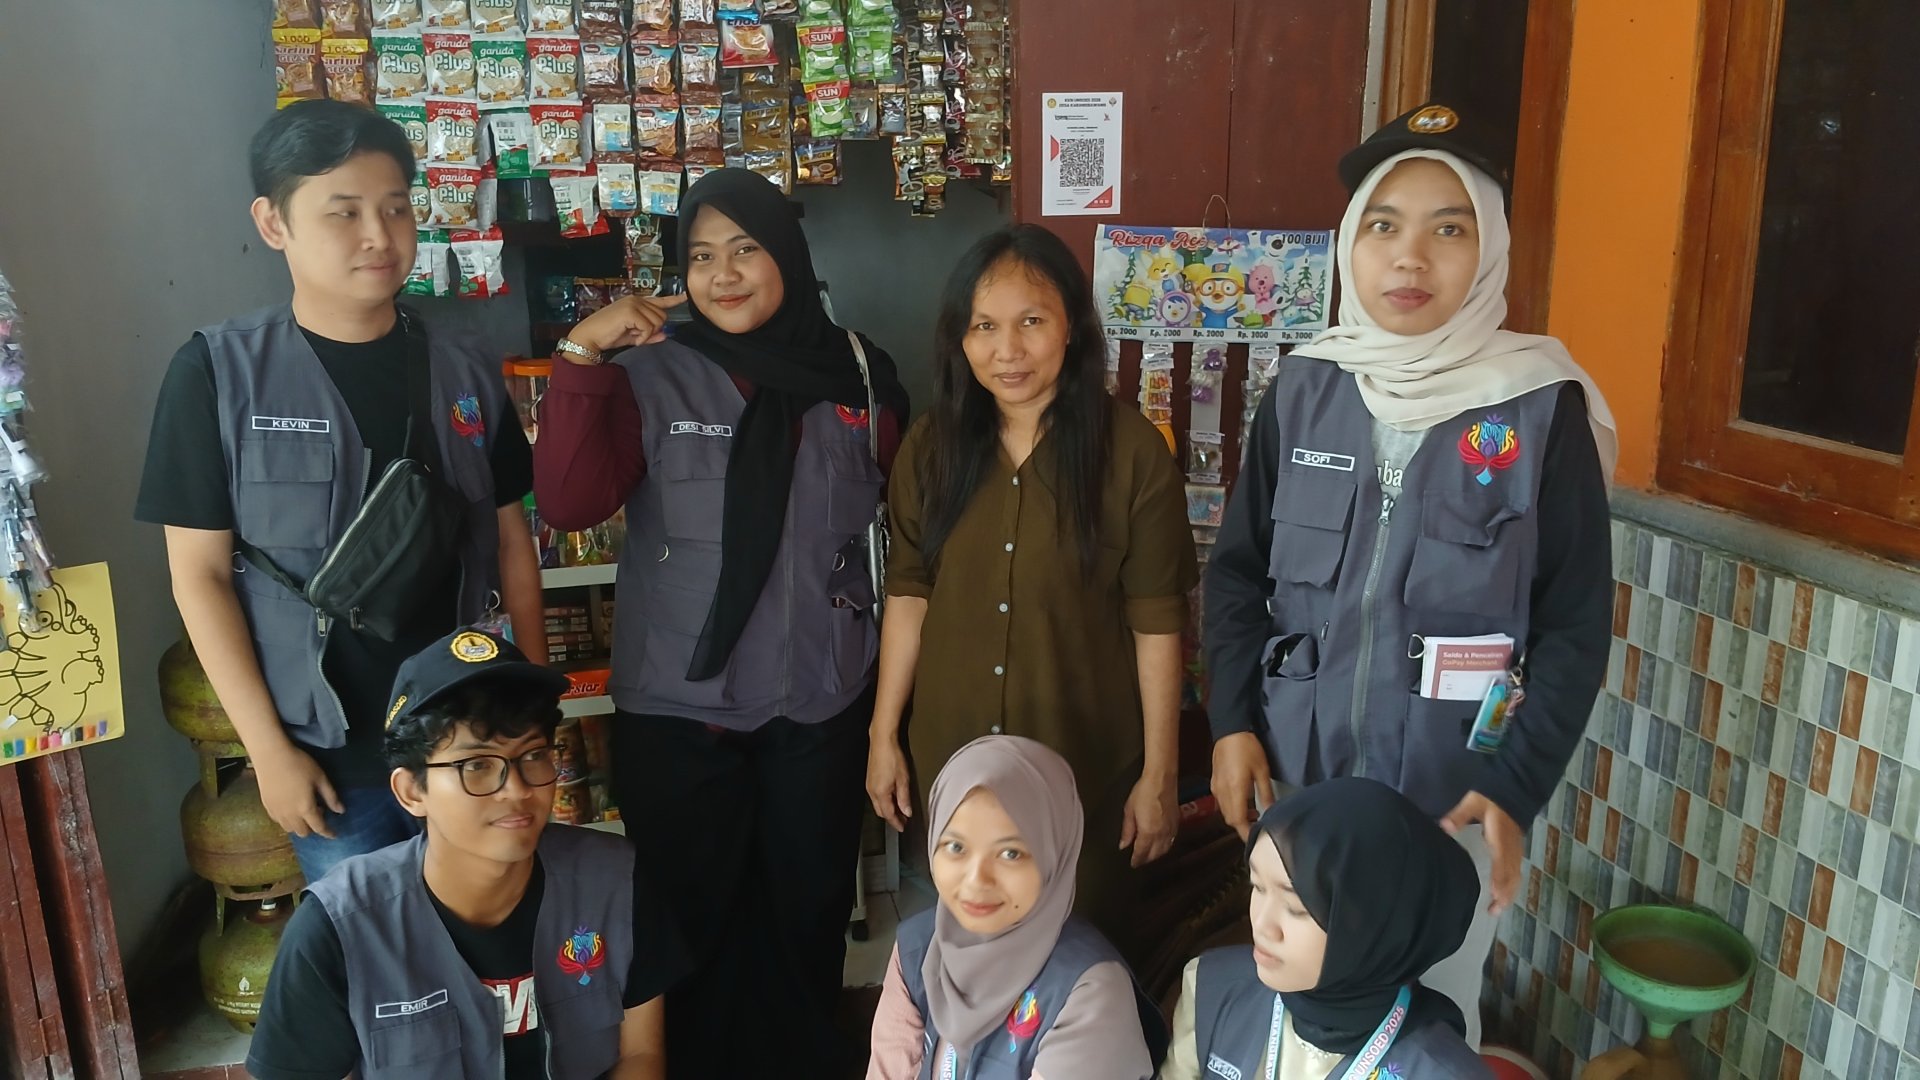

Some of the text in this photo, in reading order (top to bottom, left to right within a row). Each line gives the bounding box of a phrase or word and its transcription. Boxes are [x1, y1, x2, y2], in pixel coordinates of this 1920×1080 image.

[810, 33, 832, 42] SUN
[382, 43, 416, 51] garuda
[434, 40, 468, 48] garuda
[538, 44, 572, 52] garuda
[480, 47, 514, 56] garuda
[382, 55, 420, 73] Pilus
[434, 52, 472, 70] Pilus
[536, 56, 575, 73] Pilus
[817, 88, 839, 97] SUN
[438, 108, 472, 116] garuda
[541, 110, 574, 118] garuda
[437, 119, 474, 137] Pilus
[541, 121, 578, 139] Pilus
[439, 174, 473, 182] garuda
[438, 186, 475, 204] Pilus
[1282, 233, 1325, 245] 100 BIJI
[633, 278, 656, 288] TOP
[1193, 329, 1204, 337] Rp.
[1238, 331, 1248, 339] Rp.
[272, 419, 309, 429] KEVIN
[679, 423, 699, 431] DESI
[1303, 453, 1330, 463] SOFI
[401, 1000, 428, 1012] EMIR
[1355, 1032, 1389, 1075] UNSOED
